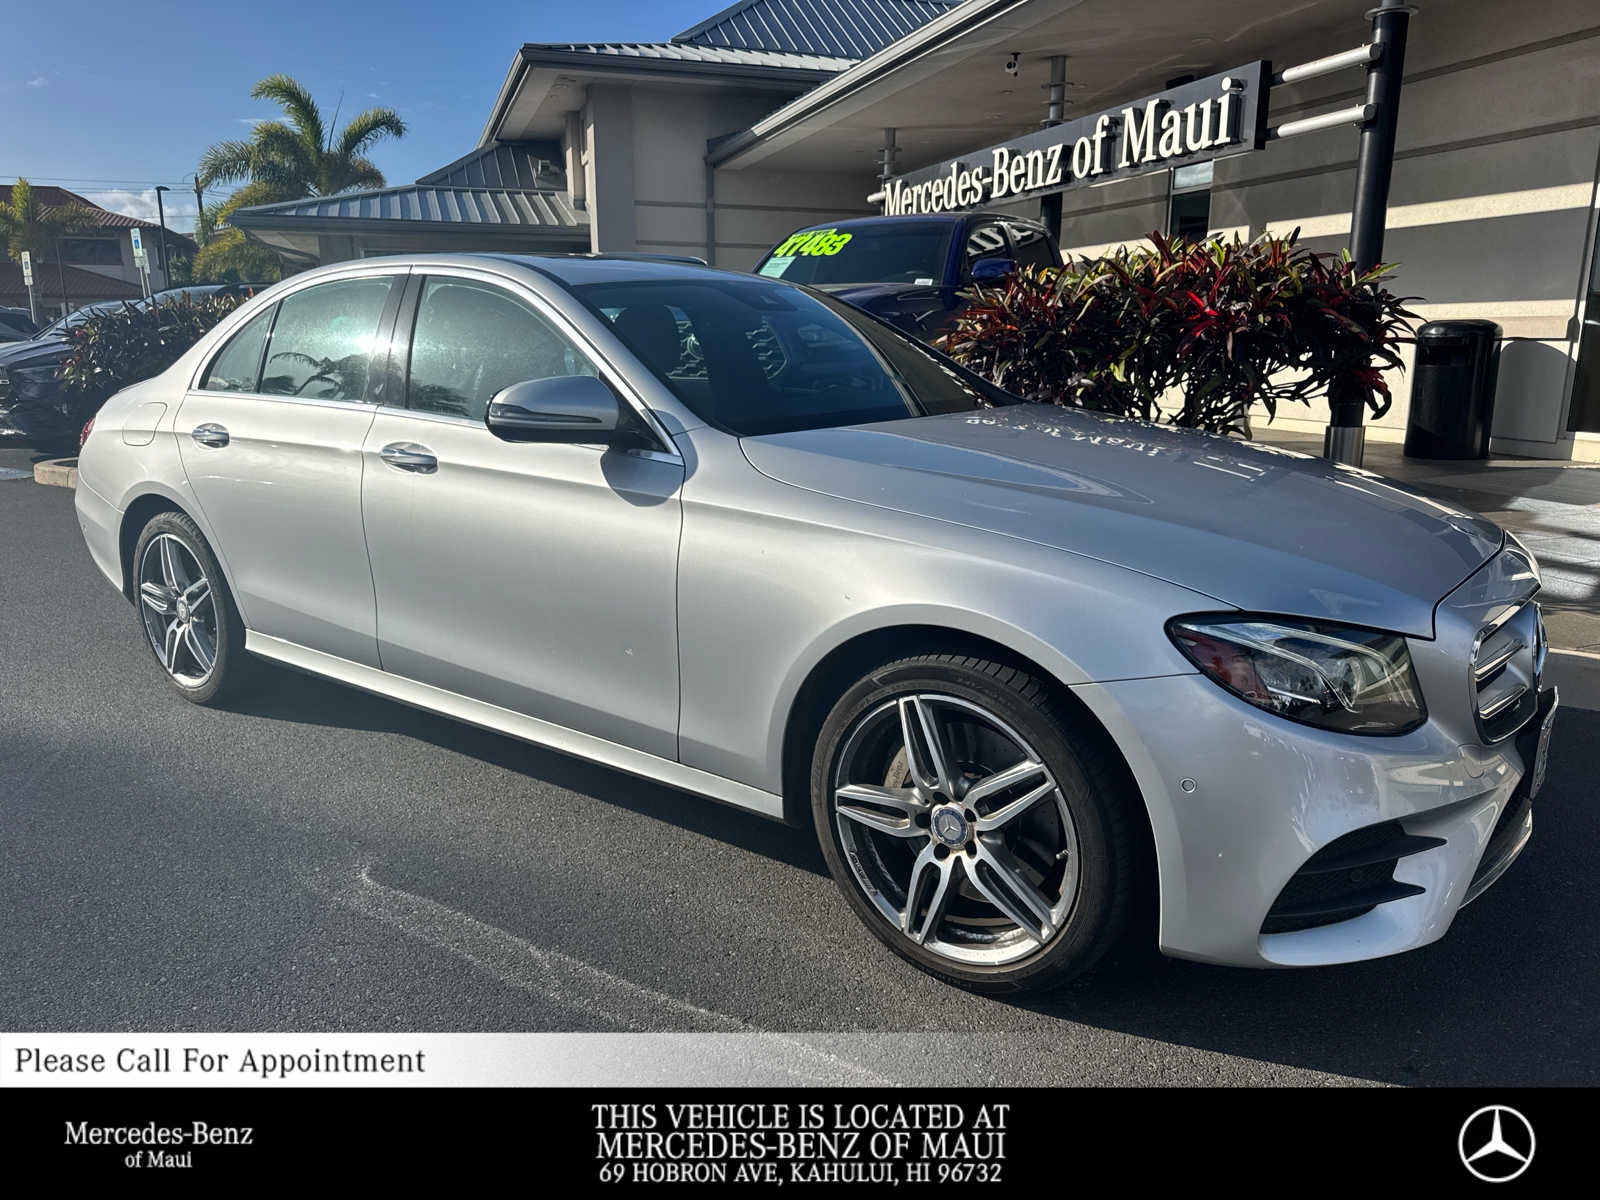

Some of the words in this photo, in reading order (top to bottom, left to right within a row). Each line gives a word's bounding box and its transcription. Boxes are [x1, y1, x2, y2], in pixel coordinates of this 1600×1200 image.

[884, 143, 1064, 217] Mercedes-Benz
[1072, 114, 1110, 179] of
[1117, 76, 1231, 169] Maui
